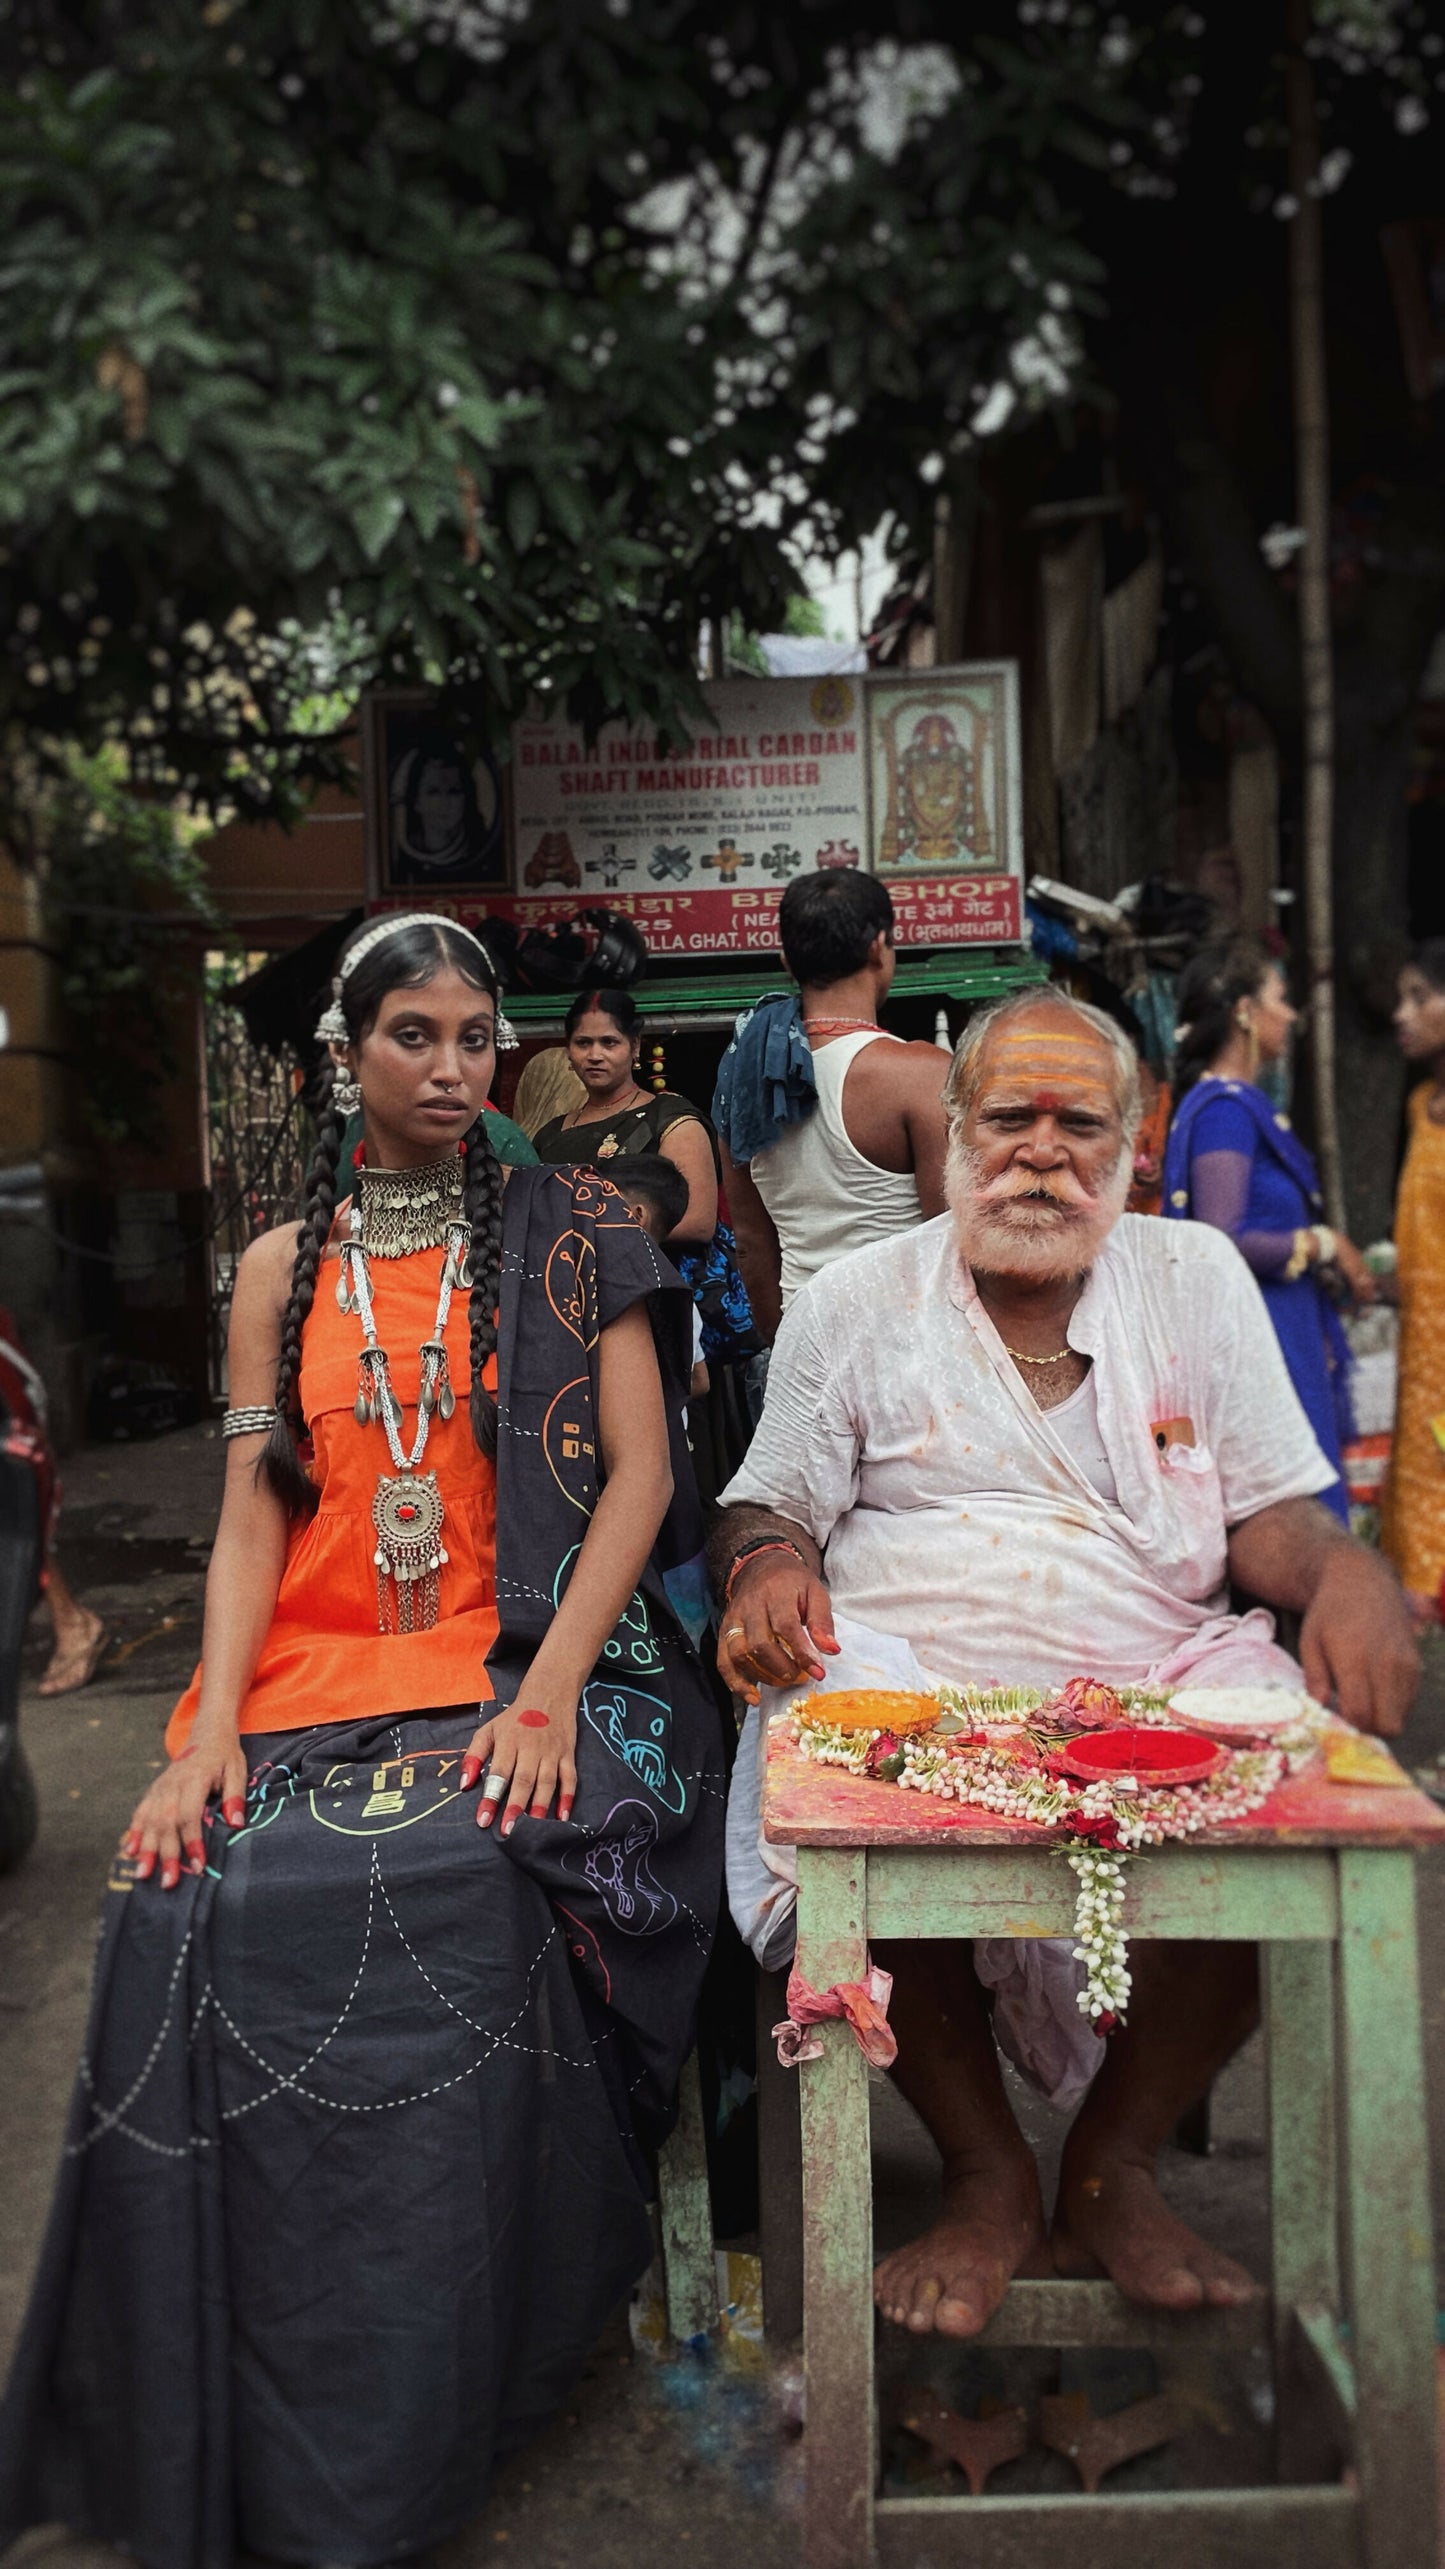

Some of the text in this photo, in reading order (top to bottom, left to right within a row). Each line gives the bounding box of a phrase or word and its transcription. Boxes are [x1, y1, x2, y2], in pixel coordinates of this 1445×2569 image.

[559, 762, 820, 795] SHAFT MANUFACTURER
[731, 880, 1011, 908] BE SHOP
[893, 905, 917, 920] TE
[747, 931, 782, 947] KOL
